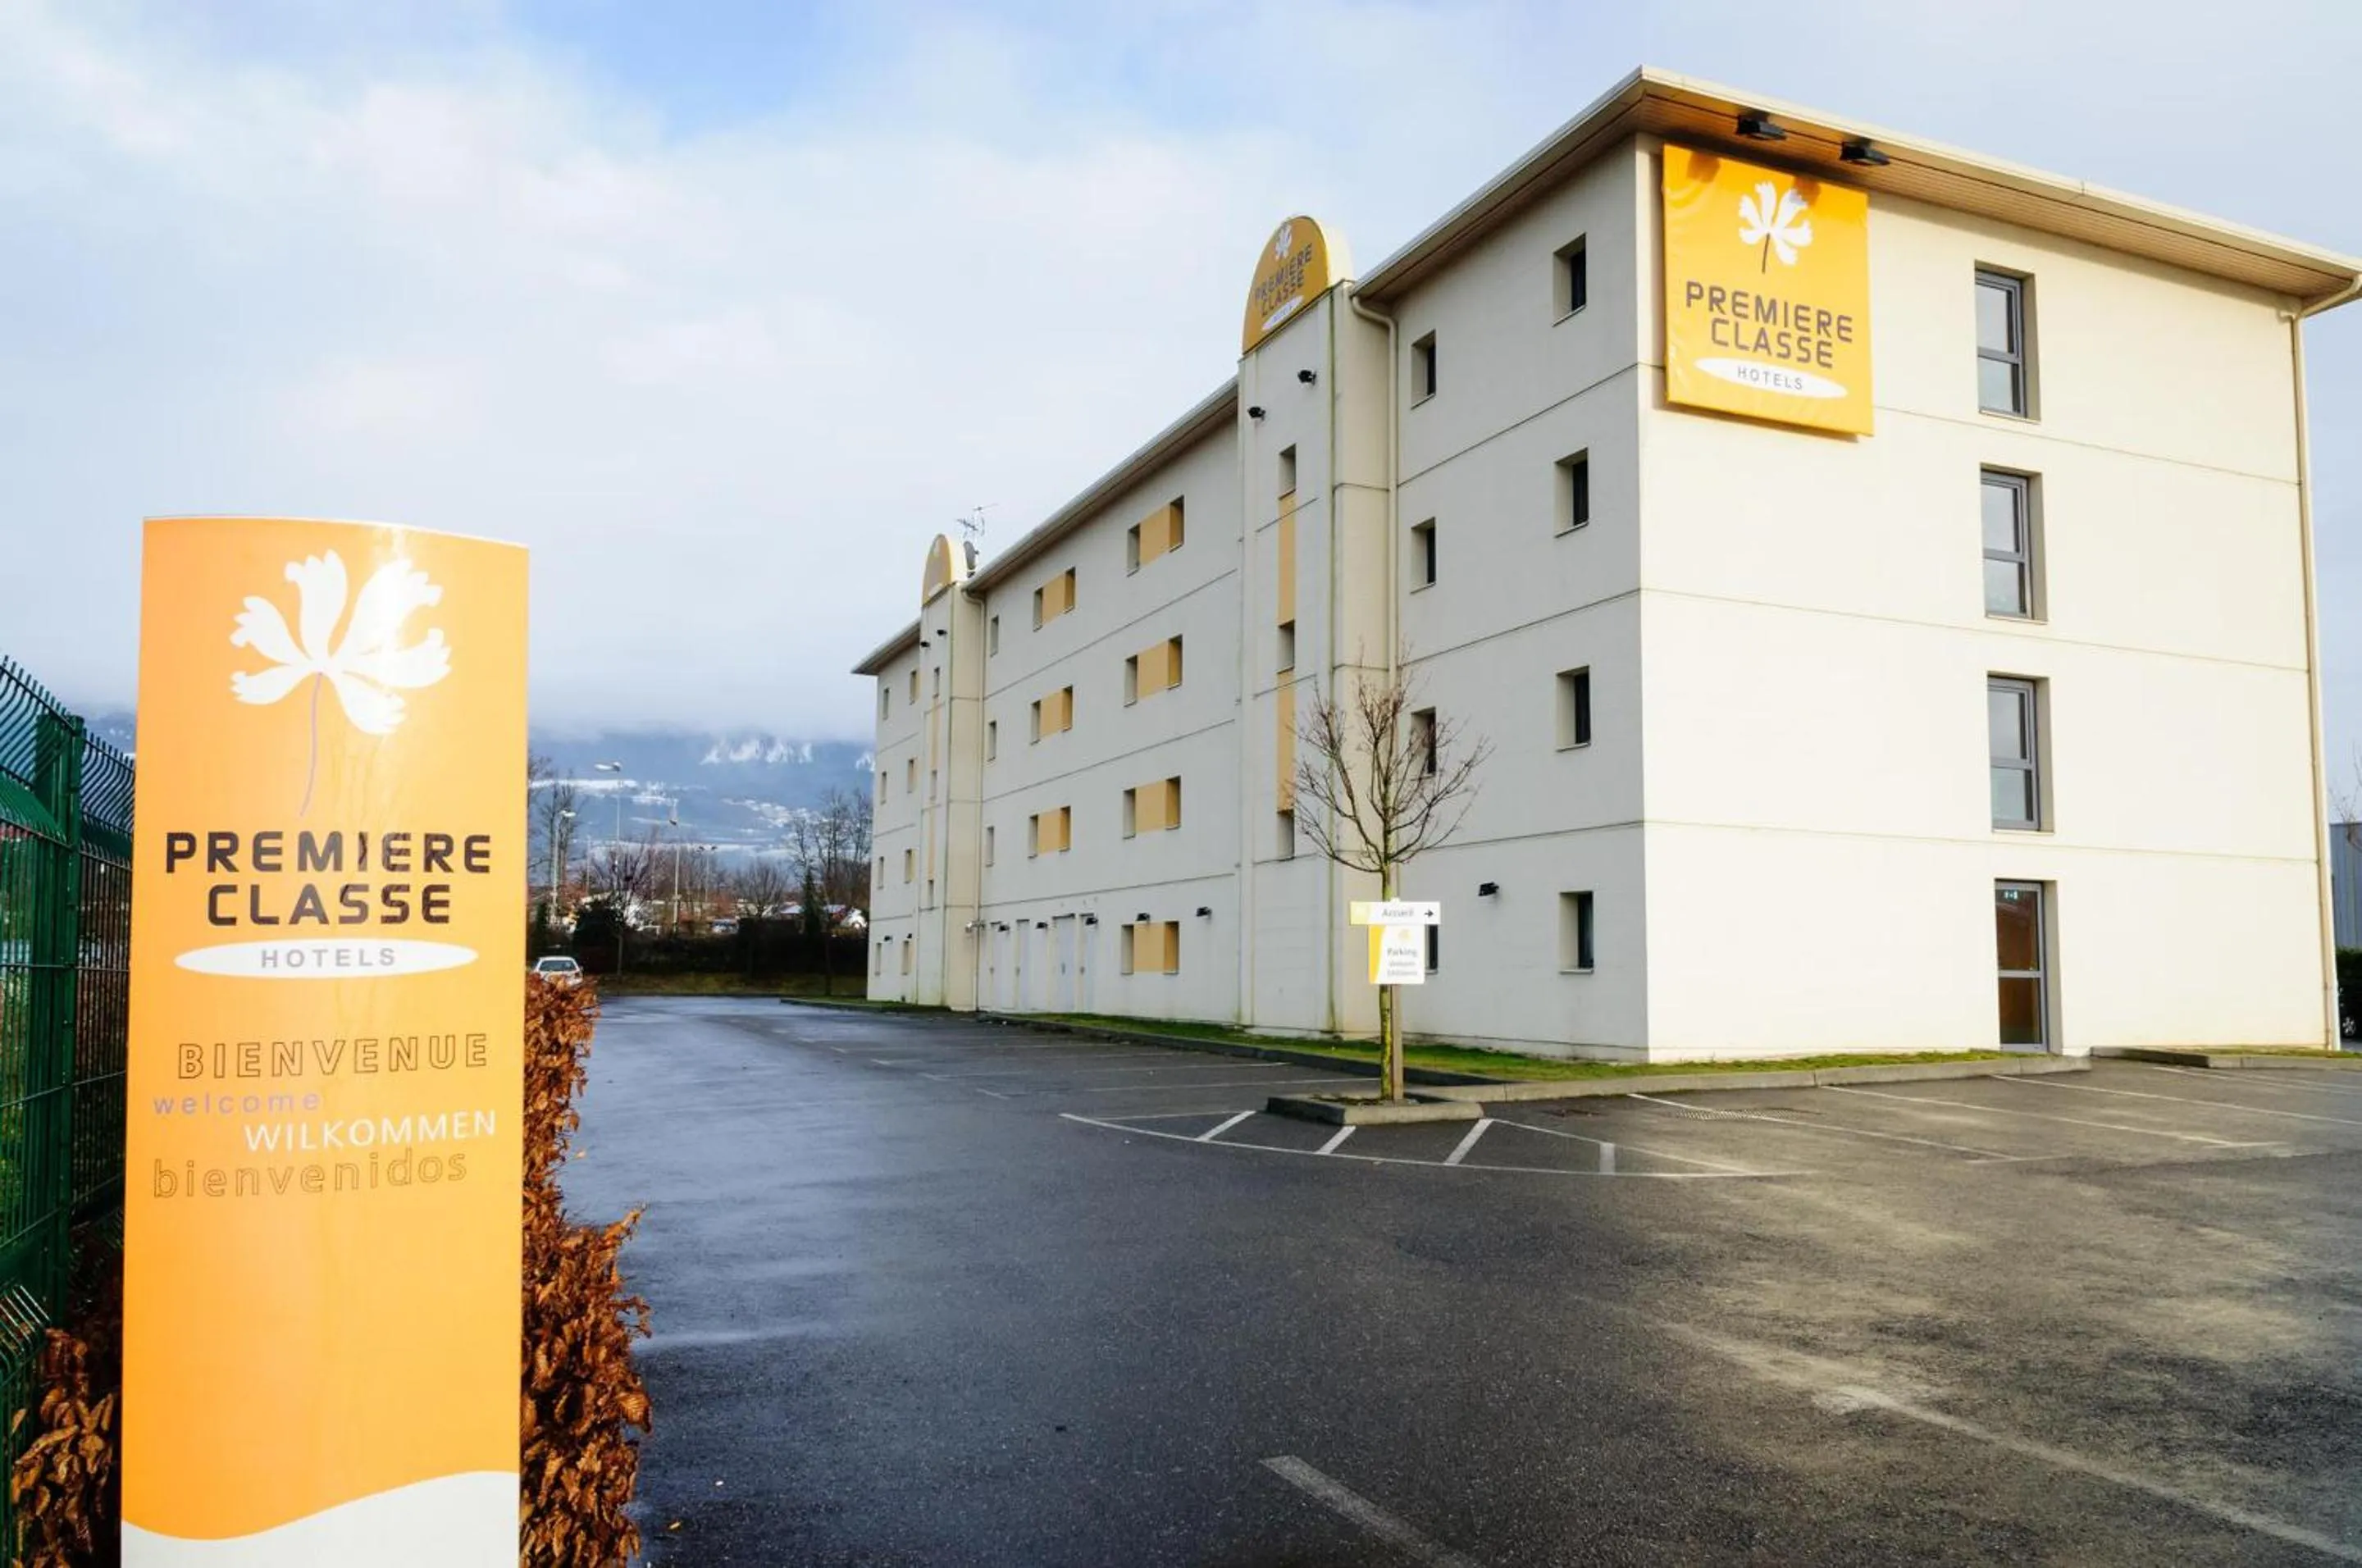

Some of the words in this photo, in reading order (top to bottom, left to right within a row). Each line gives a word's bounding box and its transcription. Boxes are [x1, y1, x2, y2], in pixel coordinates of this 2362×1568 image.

[1255, 243, 1312, 299] PREMIERE
[1685, 280, 1853, 343] PREMIERE
[1711, 318, 1833, 369] CLASSE
[1737, 366, 1803, 390] HOTELS
[165, 831, 490, 874] PREMIERE
[207, 883, 450, 926] CLASSE
[261, 947, 396, 968] HOTELS
[178, 1033, 487, 1079] BIENVENUE
[153, 1092, 320, 1115] welcome
[244, 1110, 496, 1151] WILKOMMEN
[153, 1148, 467, 1198] bienvenidos
